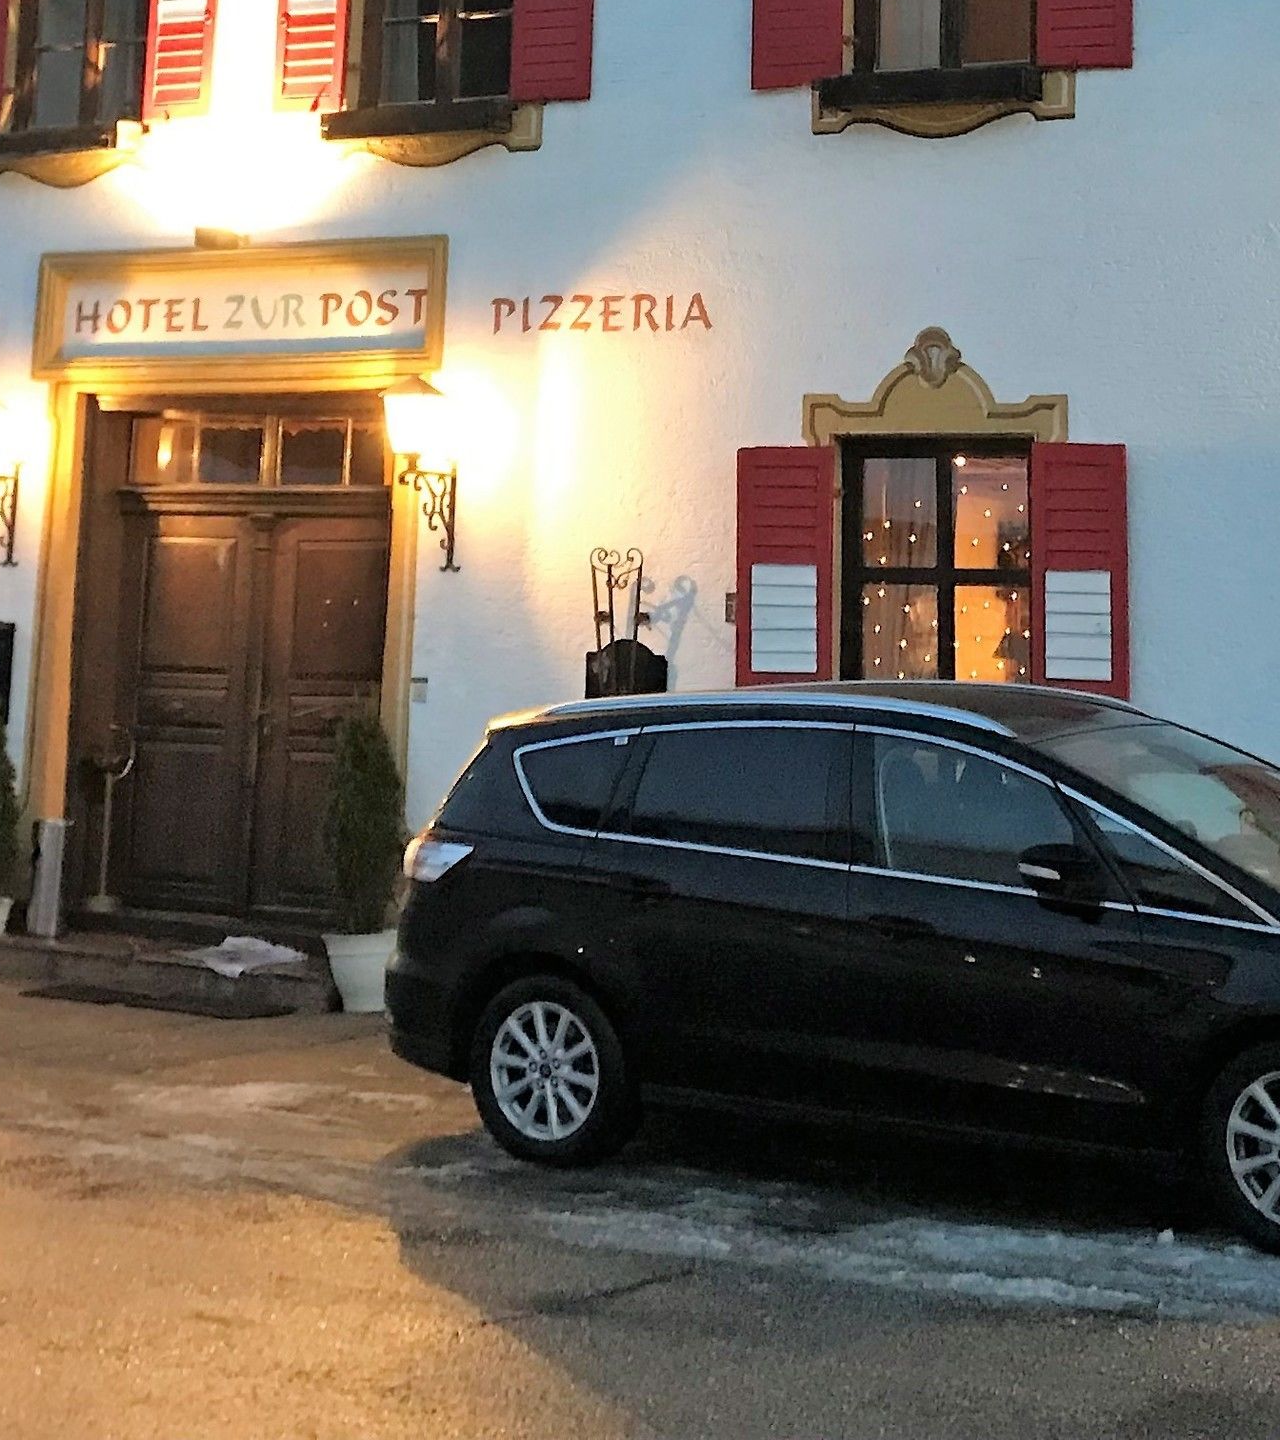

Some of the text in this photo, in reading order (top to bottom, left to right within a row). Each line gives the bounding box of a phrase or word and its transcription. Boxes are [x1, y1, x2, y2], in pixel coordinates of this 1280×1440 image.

[74, 288, 428, 335] HOTEL ZUR POST
[490, 291, 713, 336] PIZZERIA
